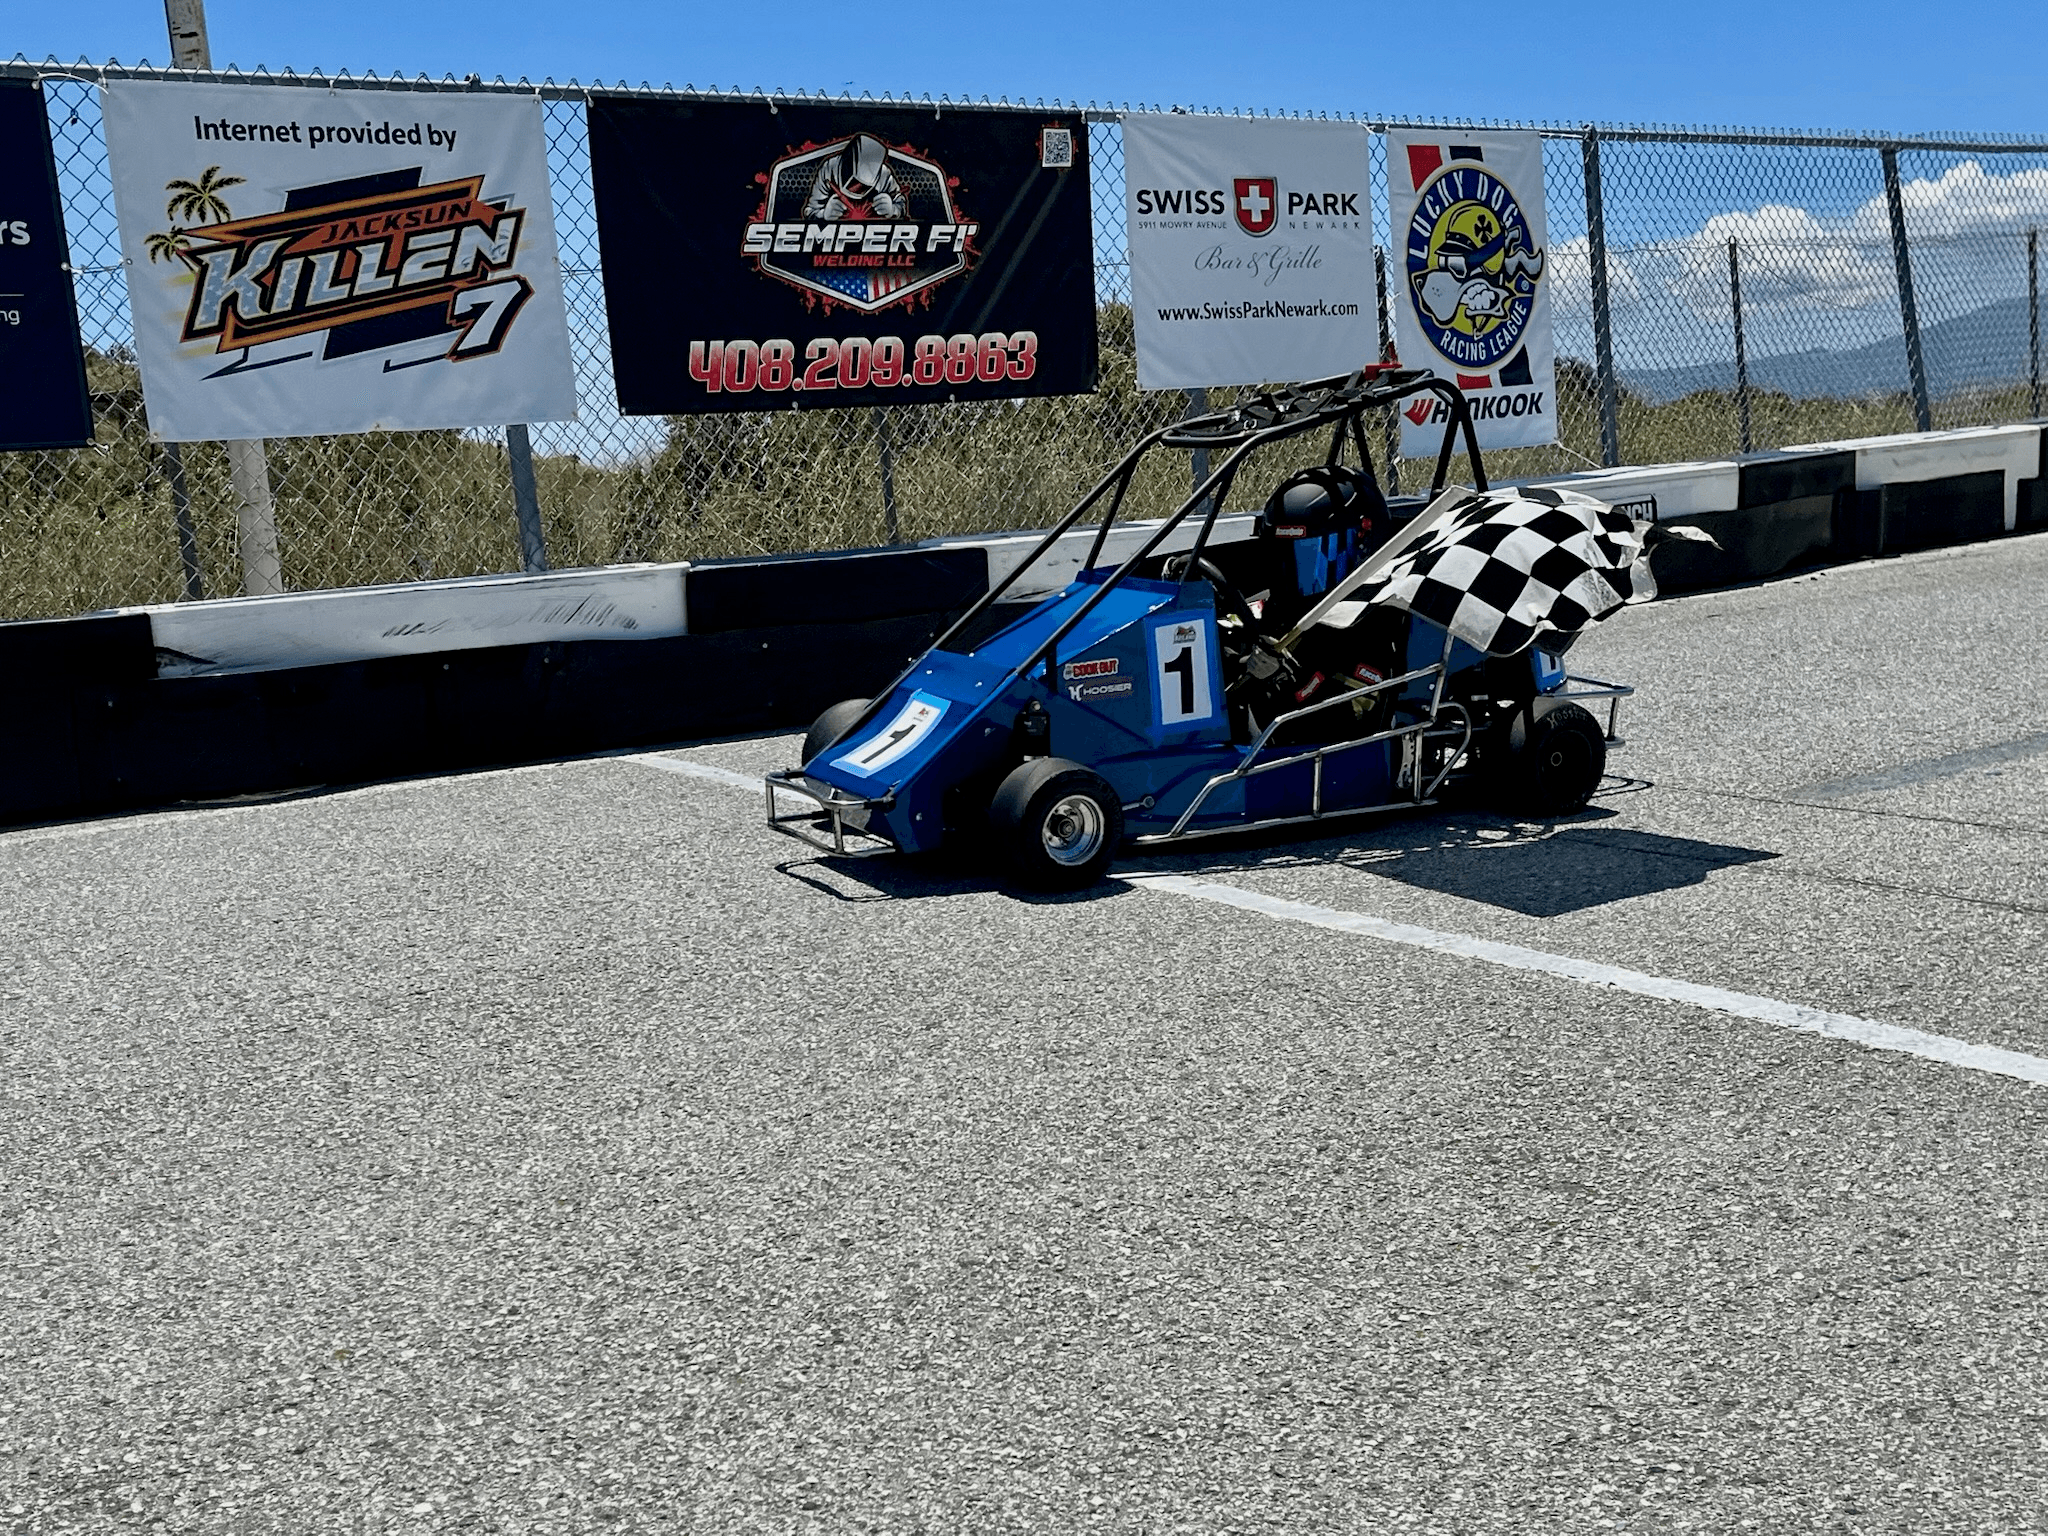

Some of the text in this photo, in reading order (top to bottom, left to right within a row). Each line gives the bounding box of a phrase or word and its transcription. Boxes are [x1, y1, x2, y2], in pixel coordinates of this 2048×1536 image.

[194, 115, 457, 152] Internet provided by
[321, 201, 473, 244] JACKSUN
[1136, 189, 1360, 216] SWISS PARK
[1408, 170, 1519, 260] LUCKY DOG
[743, 223, 919, 253] SEMPER
[1138, 221, 1227, 229] 5911 MOWRY AVENUE
[190, 215, 517, 332] KILLEN
[813, 254, 916, 267] WELDING LLC
[1194, 243, 1323, 287] Bar & Grille
[451, 278, 527, 355] 7
[1157, 299, 1359, 321] www.SwissParkNewark.com
[1439, 300, 1528, 362] RACING LEAGUE
[688, 330, 1038, 393] 408.209.8863
[1430, 391, 1544, 424] HNKOOK
[1083, 682, 1132, 696] HOOSIER
[1164, 646, 1195, 715] 1
[860, 723, 917, 765] 1
